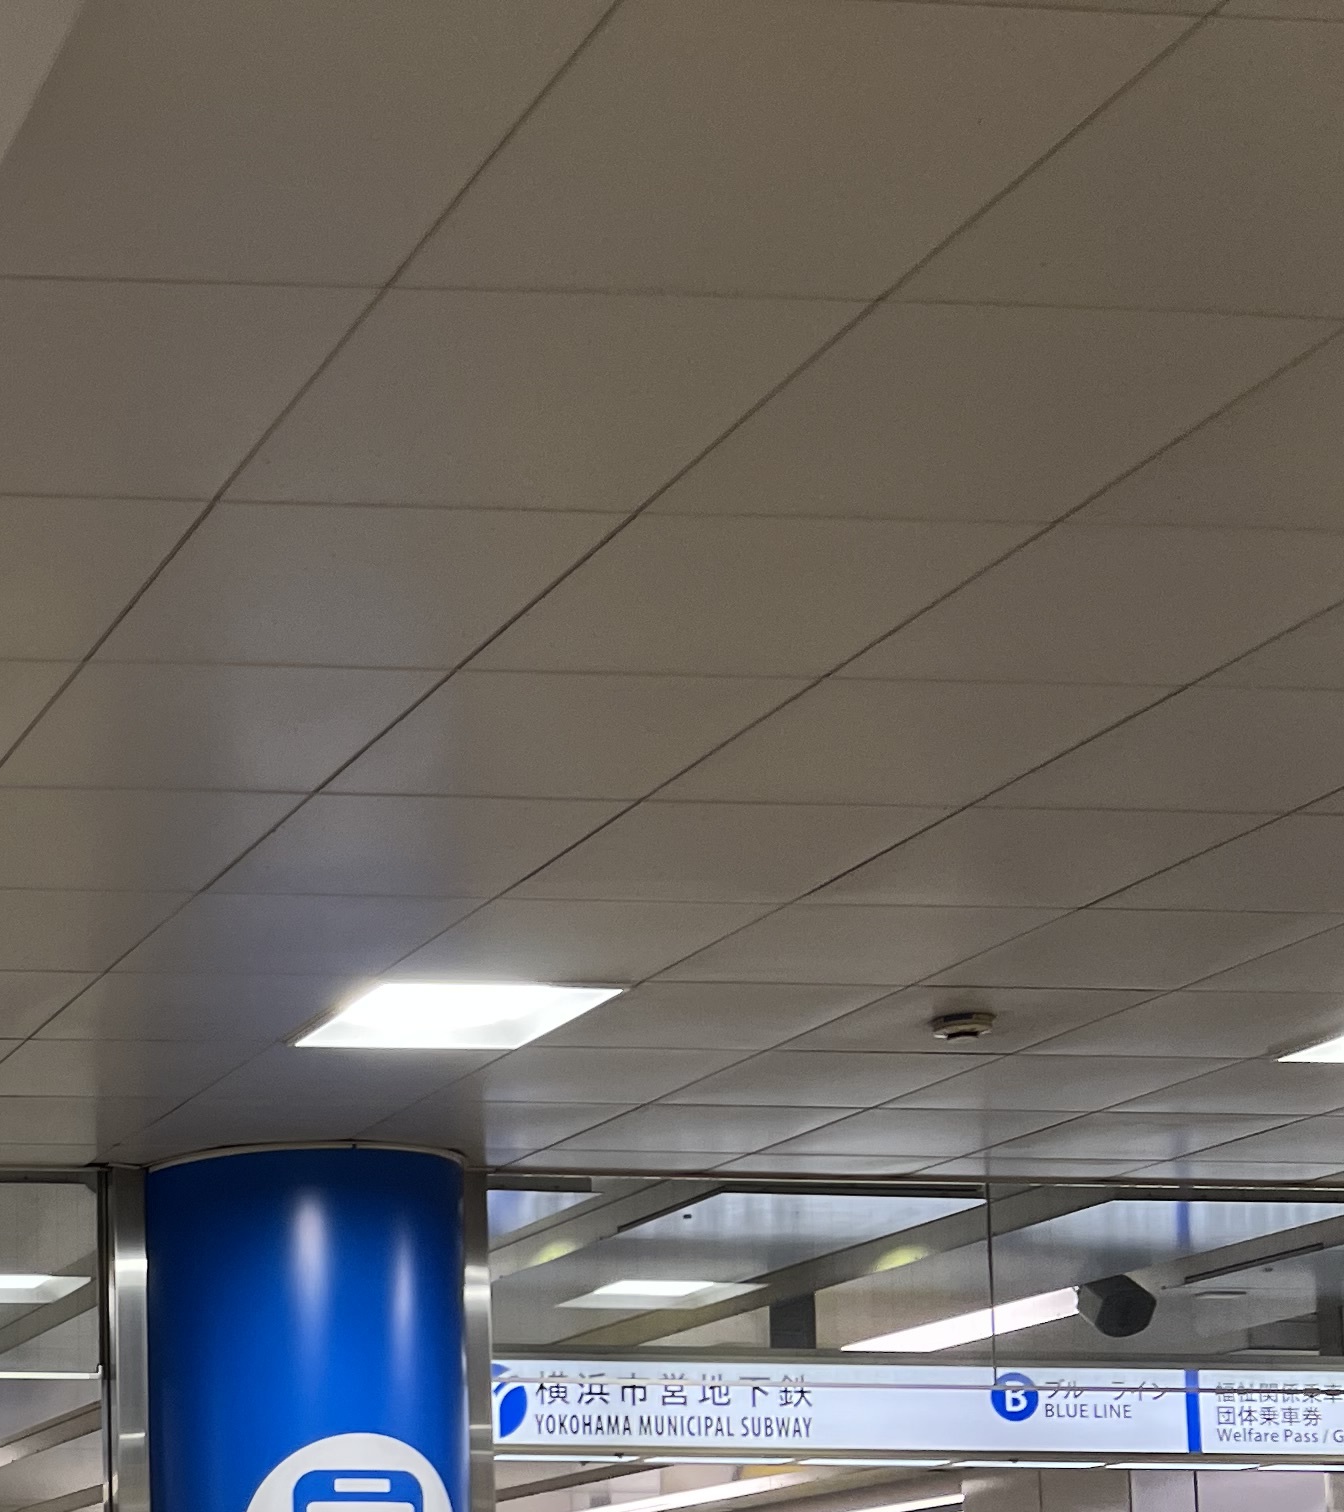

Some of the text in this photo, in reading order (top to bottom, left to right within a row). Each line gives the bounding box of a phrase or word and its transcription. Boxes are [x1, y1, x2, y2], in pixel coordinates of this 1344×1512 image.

[535, 1371, 813, 1407] 横浜市営地下鉄
[1044, 1403, 1132, 1419] BLUE LINE
[1217, 1406, 1322, 1427] 団体乗車券
[535, 1413, 813, 1438] YOKOHAMA MUNICIPAL SUBWAY
[1217, 1428, 1280, 1442] Welfare
[1283, 1429, 1318, 1443] Pass
